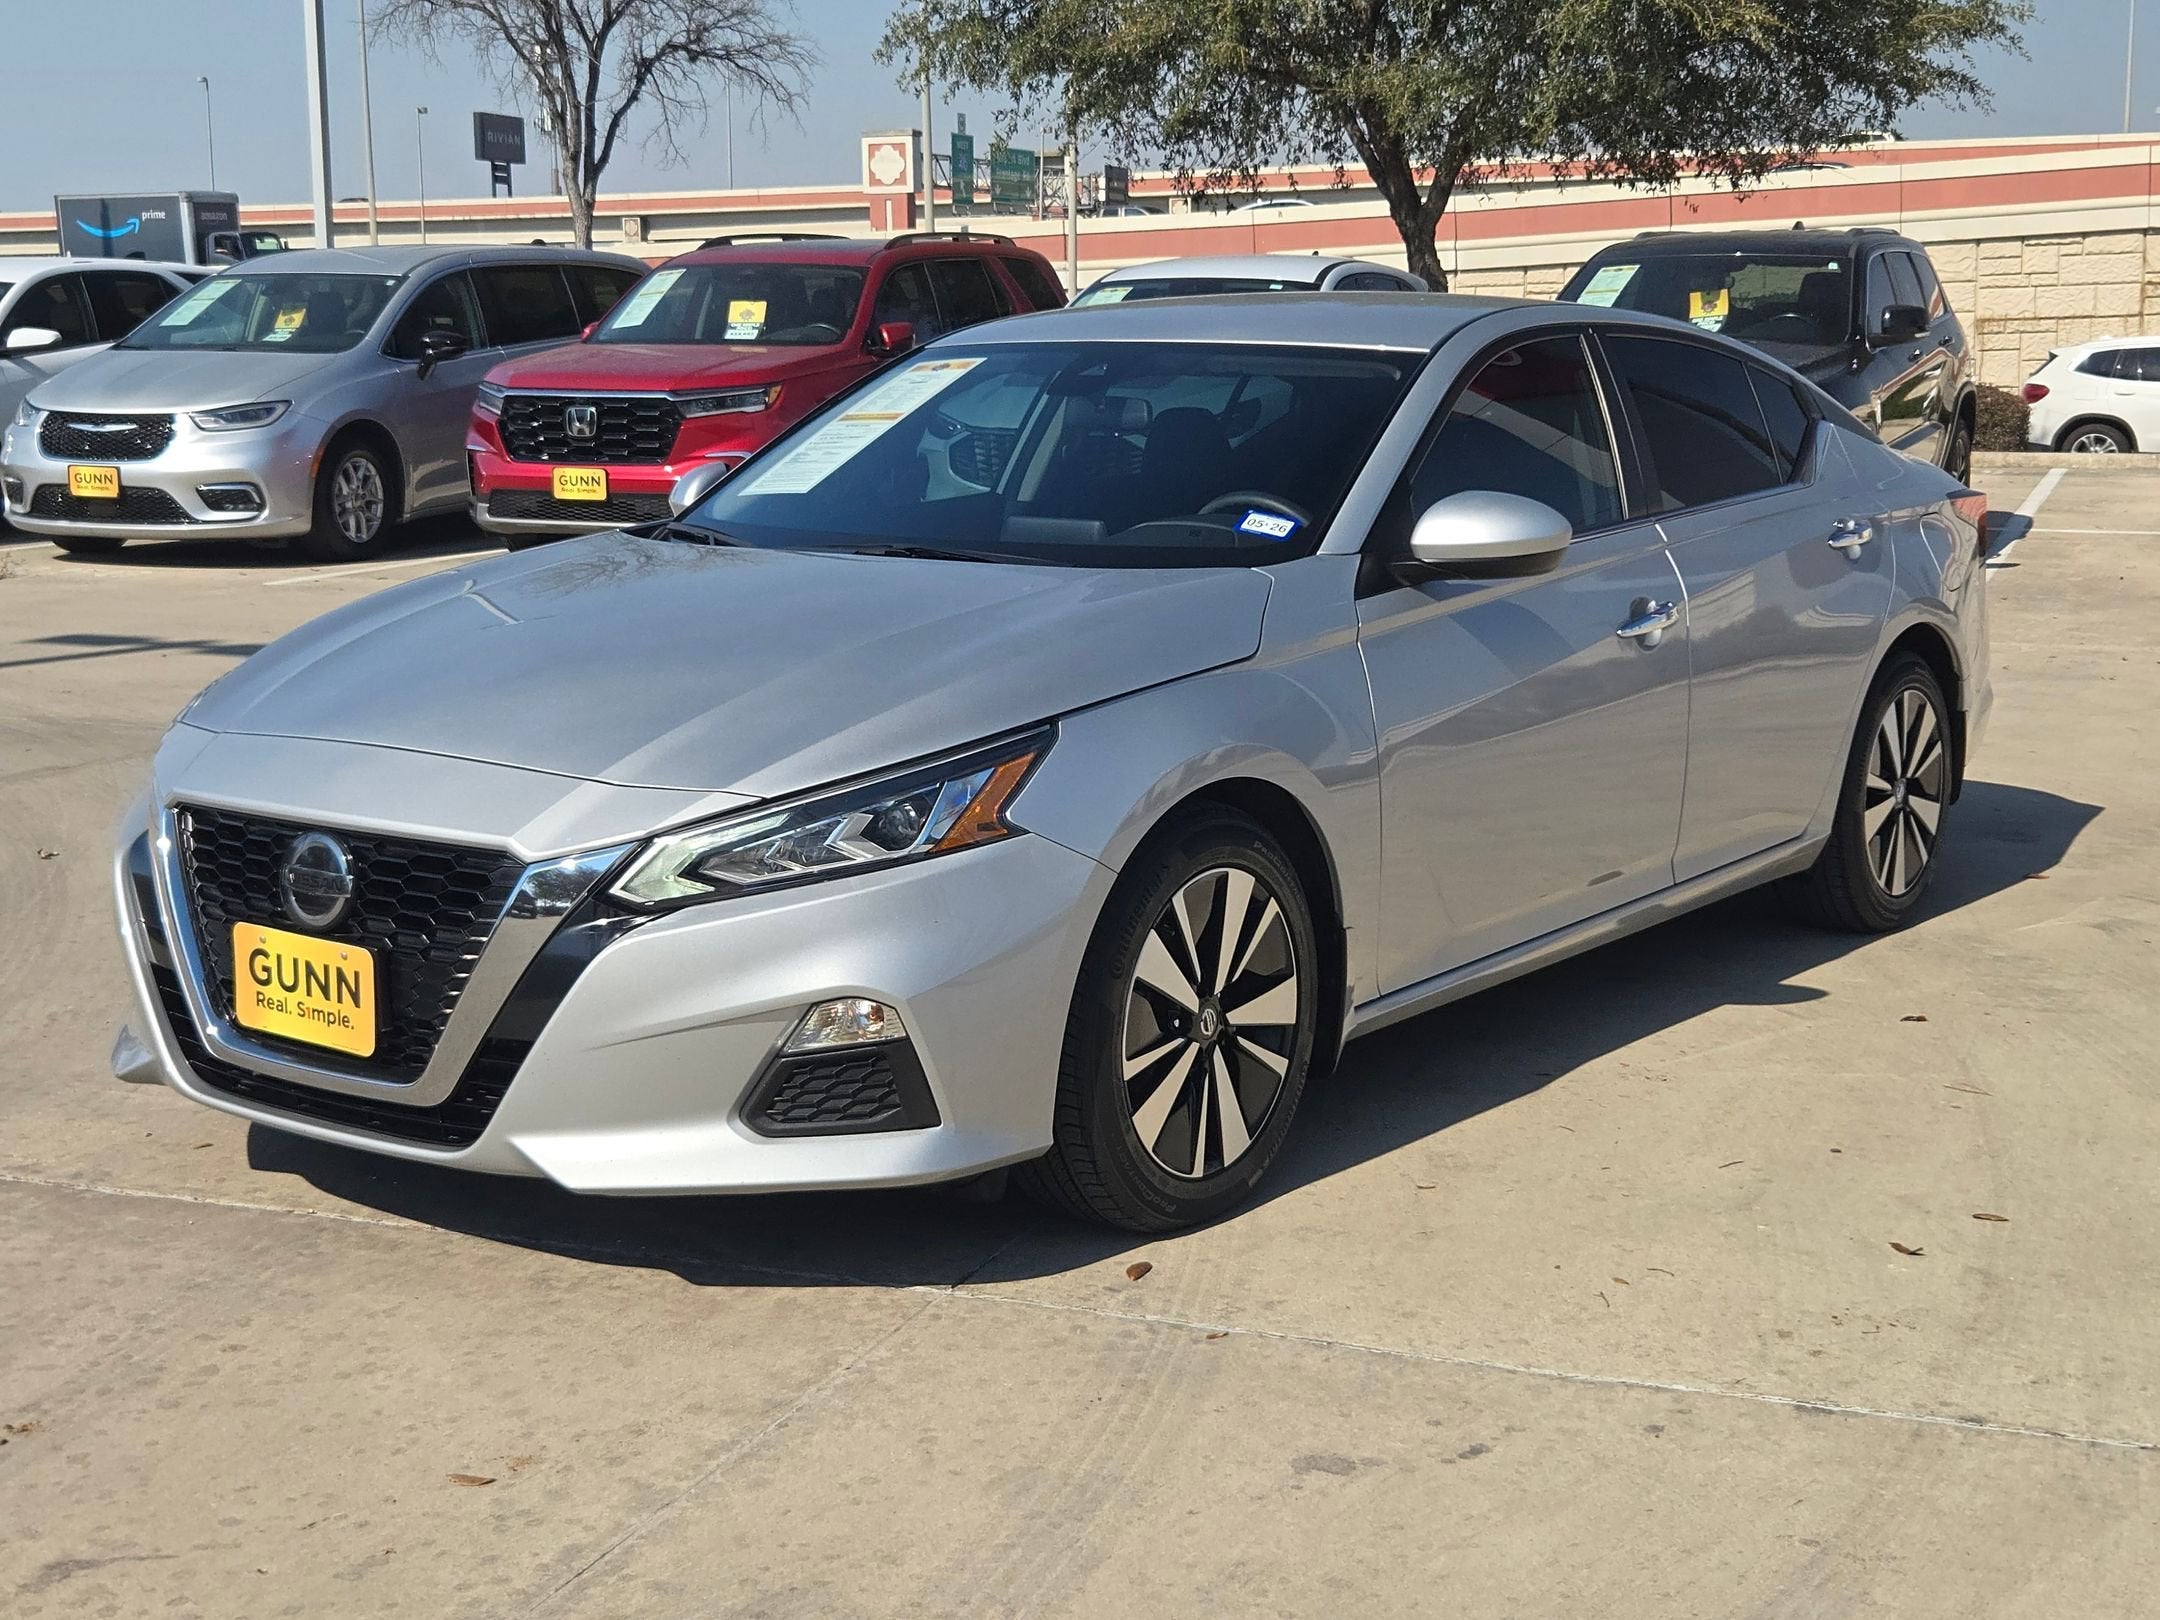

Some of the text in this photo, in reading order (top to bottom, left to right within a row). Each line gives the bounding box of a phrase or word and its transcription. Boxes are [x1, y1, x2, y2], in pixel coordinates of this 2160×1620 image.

[487, 131, 521, 145] RIVIAN
[142, 208, 166, 221] prime
[74, 472, 114, 485] GUNN
[558, 474, 601, 487] GUNN
[248, 947, 361, 1009] GUNN
[256, 990, 293, 1015] Real.
